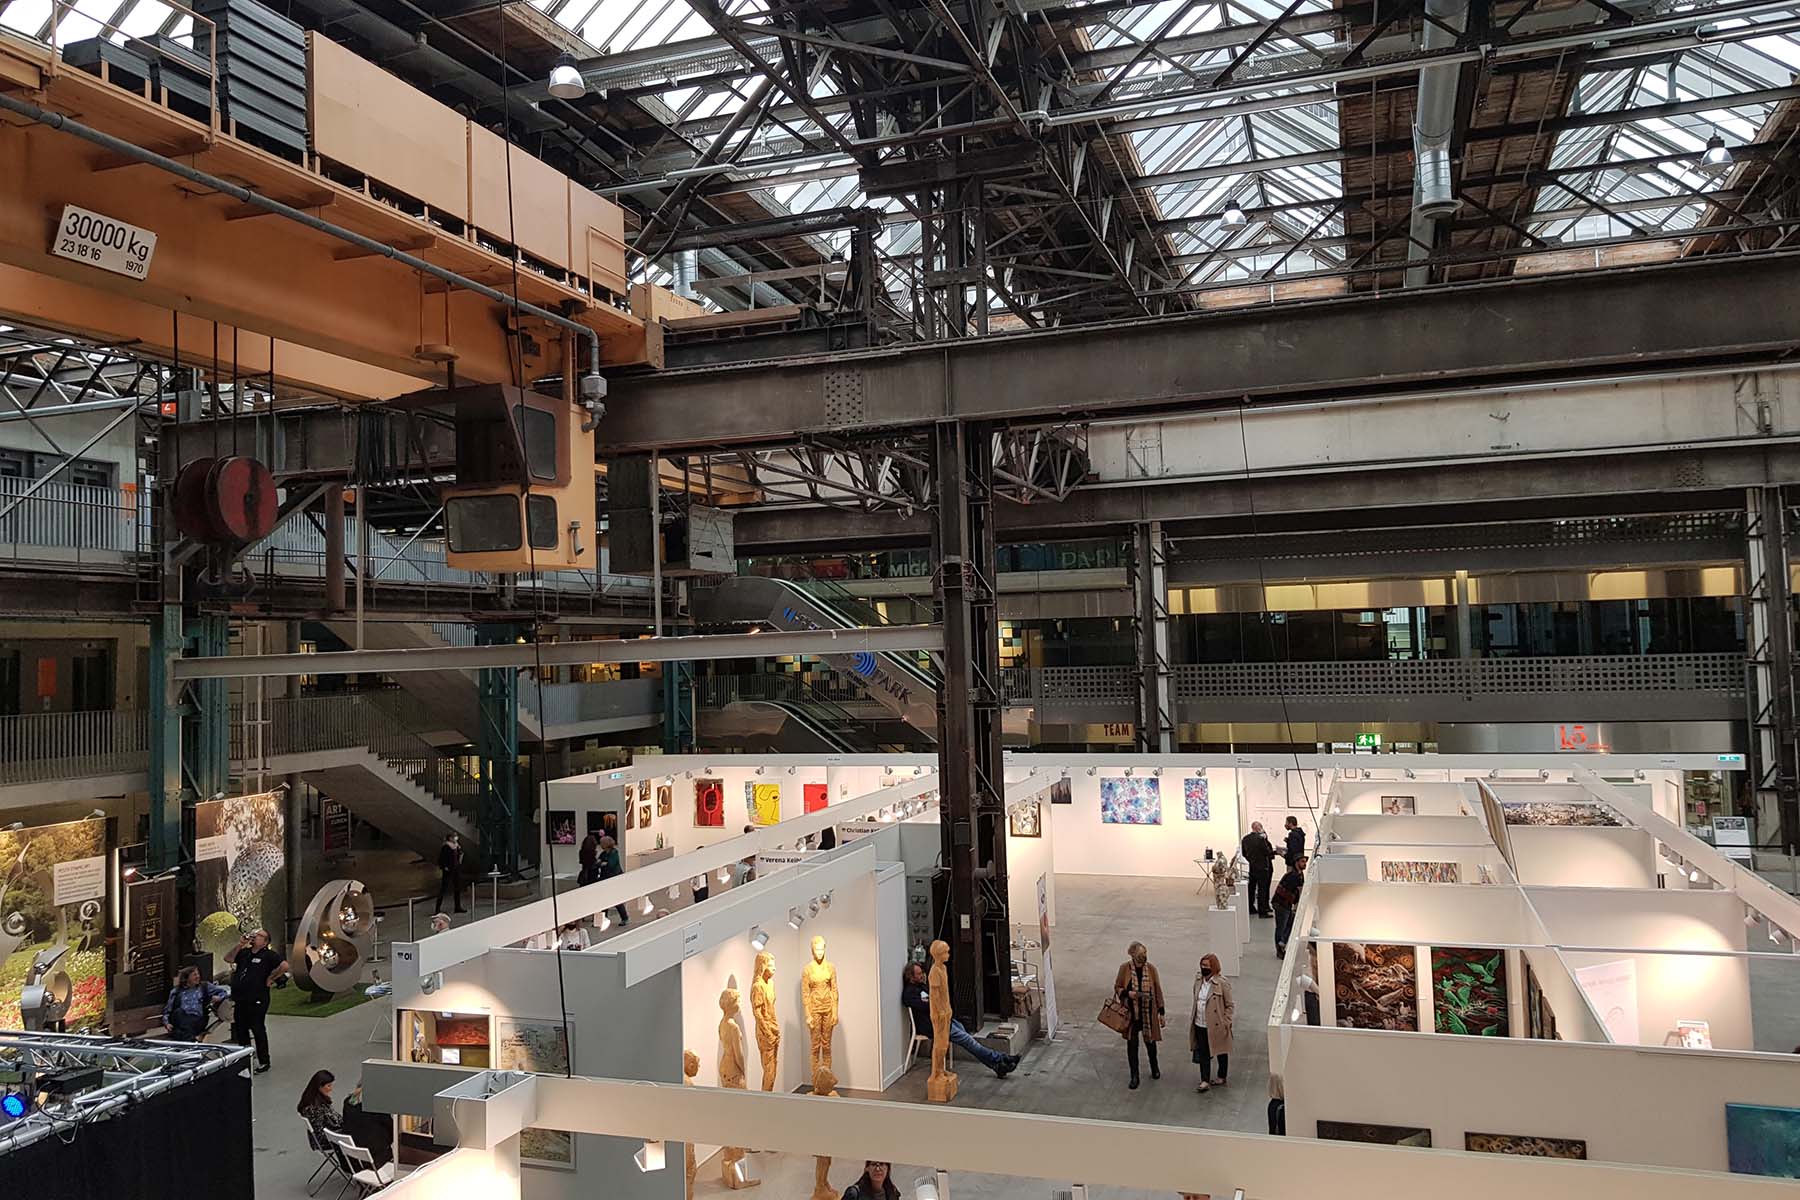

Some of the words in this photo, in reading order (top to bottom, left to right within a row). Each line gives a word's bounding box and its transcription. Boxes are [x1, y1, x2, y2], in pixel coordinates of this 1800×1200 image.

[65, 212, 127, 250] 30000
[127, 231, 149, 262] kg
[60, 239, 76, 253] 23
[77, 243, 89, 257] 18
[90, 247, 102, 261] 16
[125, 260, 144, 274] 1970
[1103, 723, 1130, 737] TEAM
